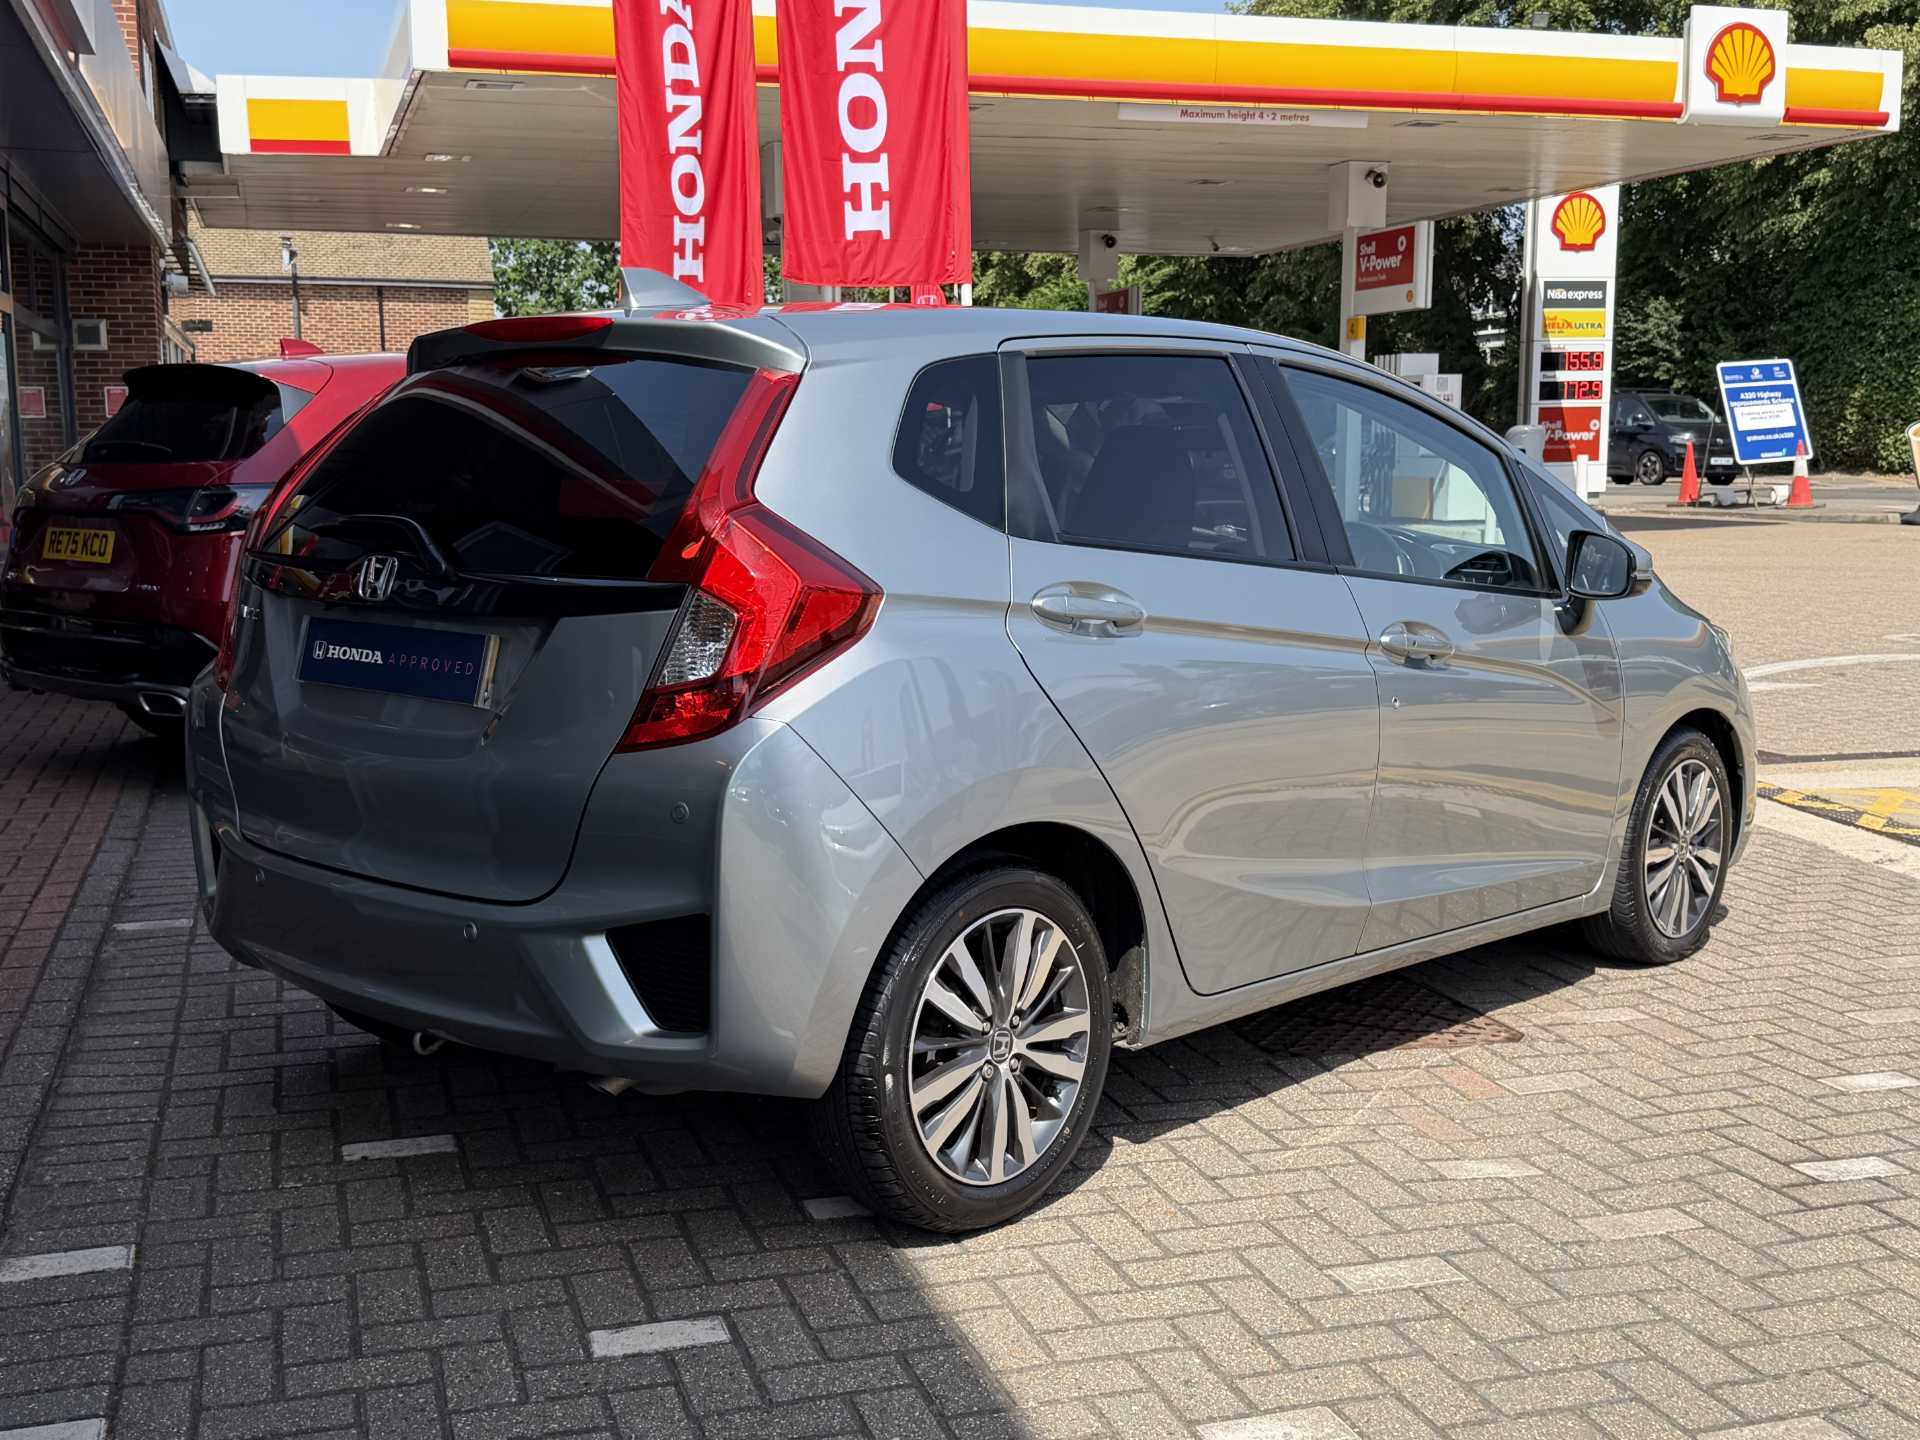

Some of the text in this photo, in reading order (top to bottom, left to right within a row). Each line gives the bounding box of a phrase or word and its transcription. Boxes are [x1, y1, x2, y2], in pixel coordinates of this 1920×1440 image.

[1180, 109, 1225, 119] Maximum
[1227, 110, 1255, 121] height
[1280, 113, 1310, 121] metres
[1360, 241, 1376, 256] Shell
[48, 531, 109, 557] RE75 KCO
[327, 644, 475, 675] HONDA APPROVED
